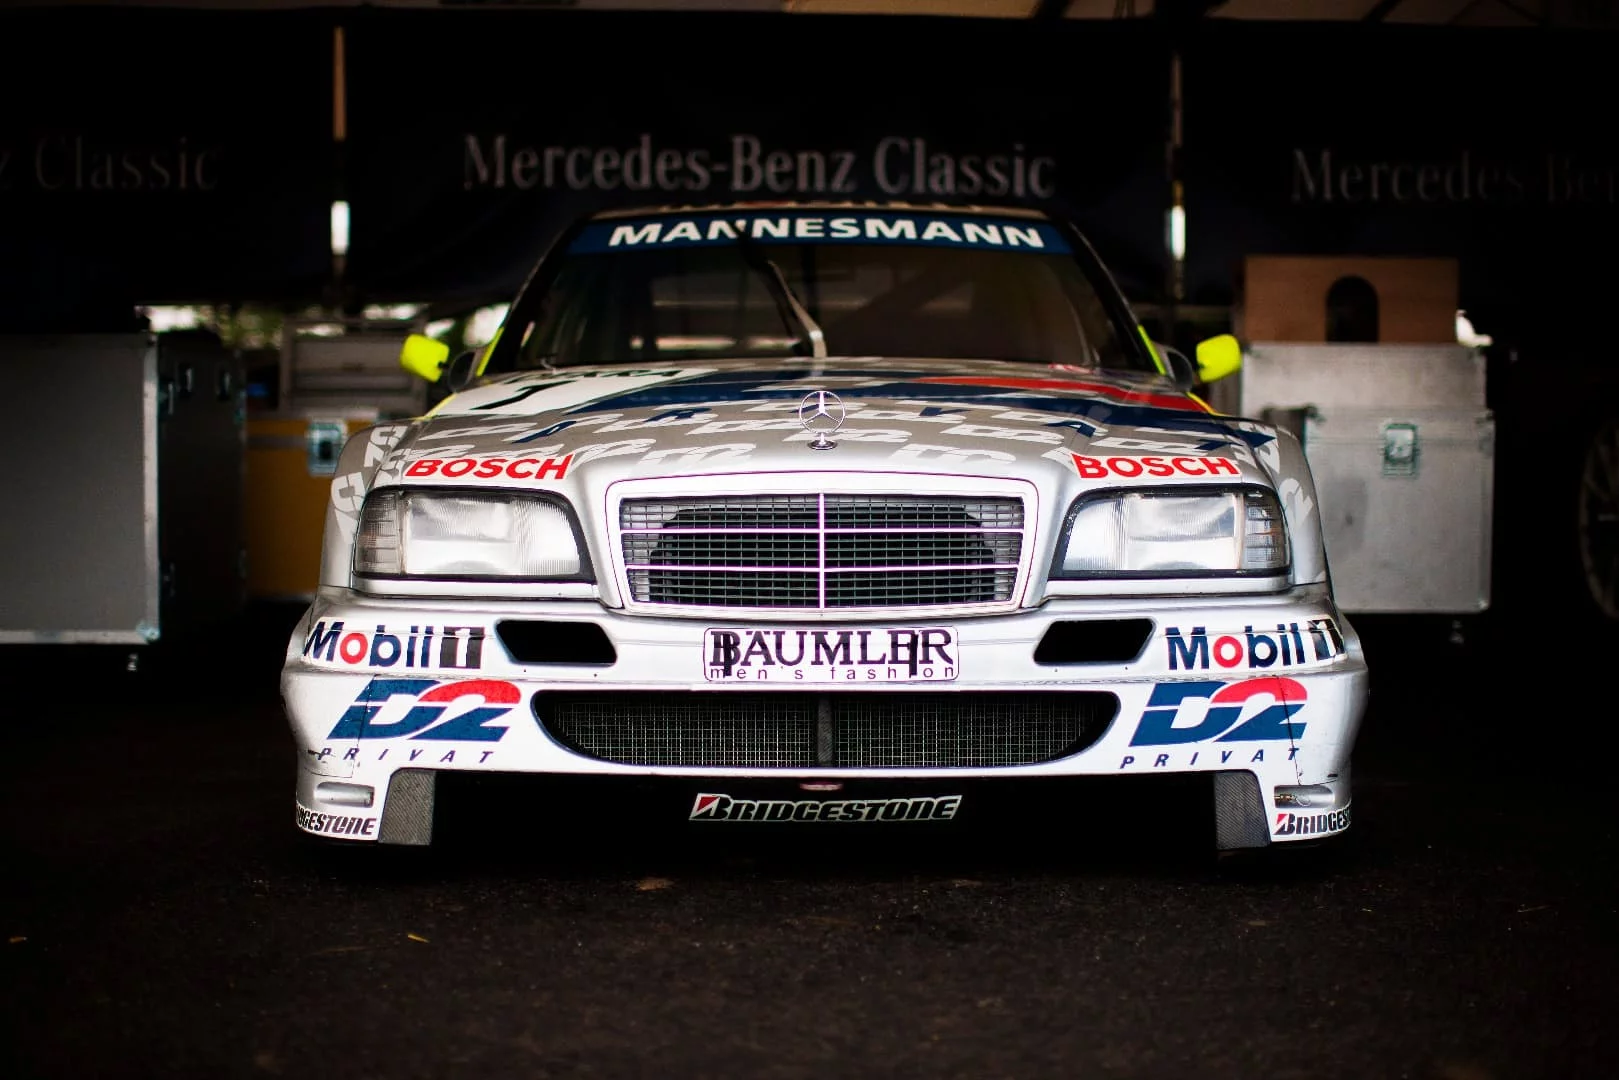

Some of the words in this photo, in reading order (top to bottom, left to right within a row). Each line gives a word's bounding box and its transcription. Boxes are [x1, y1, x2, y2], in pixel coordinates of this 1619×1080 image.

[35, 133, 219, 191] Classic
[463, 131, 858, 192] Mercedes-Benz
[872, 135, 1058, 199] Classic
[608, 218, 1044, 248] MANNESMANN
[405, 453, 574, 480] BOSCH
[1071, 453, 1240, 479] BOSCH
[304, 621, 434, 668] Mobil
[709, 629, 954, 667] BÄUMLER
[1165, 622, 1306, 670] Mobil
[326, 679, 521, 742] D2
[1129, 676, 1308, 747] D2
[317, 747, 494, 764] PRIVAT
[1120, 748, 1300, 769] PRIVAT
[689, 792, 963, 822] BRIDGESTONE
